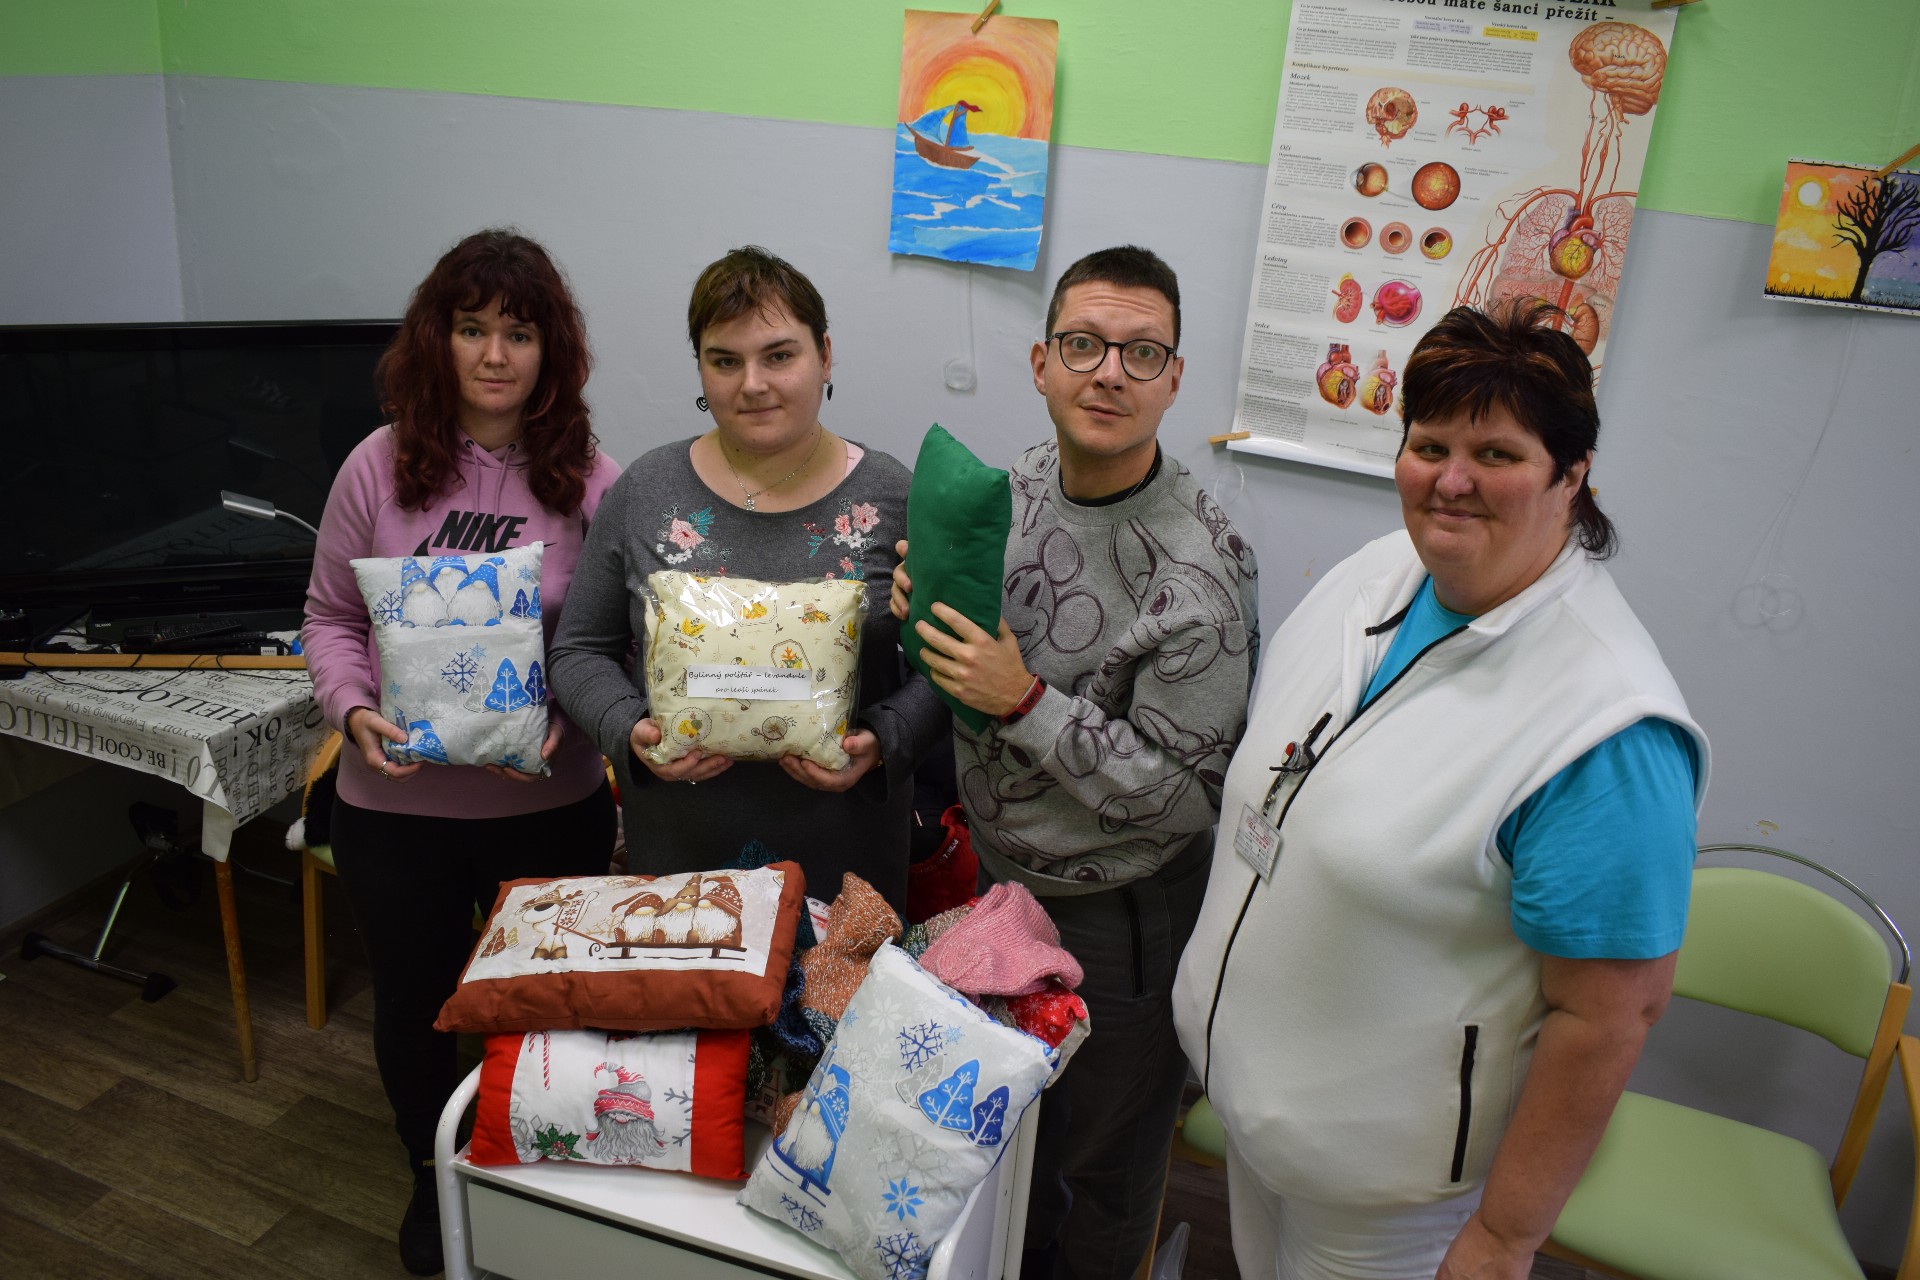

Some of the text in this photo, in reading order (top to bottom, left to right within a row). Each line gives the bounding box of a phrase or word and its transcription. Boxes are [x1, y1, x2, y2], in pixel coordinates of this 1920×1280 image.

[1493, 0, 1538, 15] šanci
[1546, 6, 1598, 21] přežít
[432, 510, 528, 553] NIKE
[688, 671, 722, 680] Bylinný
[724, 671, 753, 680] polštář
[765, 671, 806, 679] levandule
[137, 689, 257, 728] HELLO
[96, 735, 143, 761] COOL
